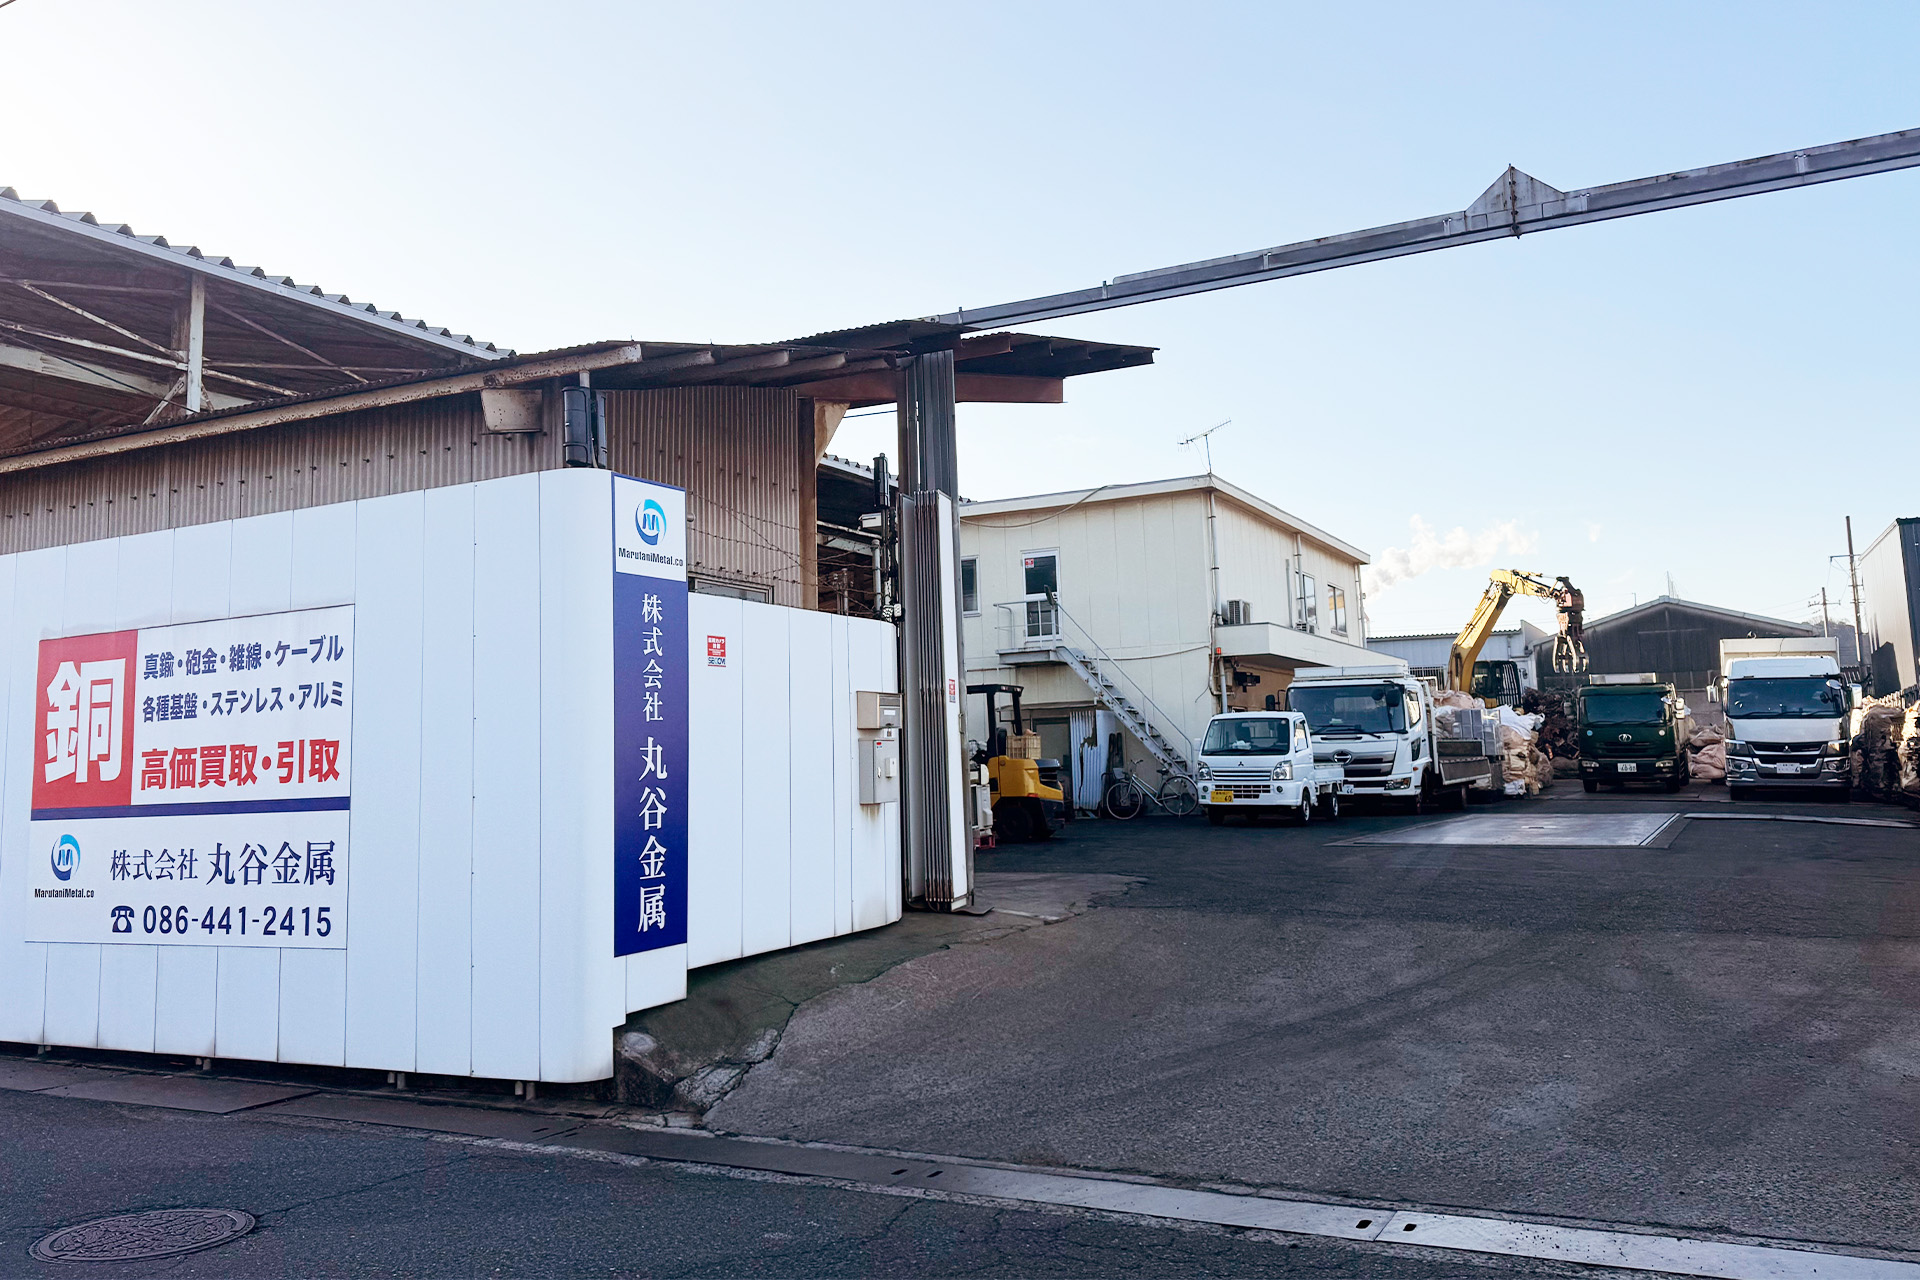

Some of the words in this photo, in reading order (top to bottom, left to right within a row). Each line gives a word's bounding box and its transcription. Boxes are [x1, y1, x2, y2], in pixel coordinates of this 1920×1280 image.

[618, 546, 684, 567] MarutaniMetal.co
[641, 594, 664, 722] 株式会社
[708, 656, 726, 665] SECOM
[45, 658, 126, 783] 銅
[143, 680, 343, 722] 各種基盤・ステンレス・アルミ
[140, 739, 340, 790] 高価買取・引取
[637, 736, 667, 932] 丸谷金属
[110, 849, 199, 882] 株式会社
[207, 840, 336, 886] 丸谷金属
[34, 888, 94, 899] MarutaniMetal.co
[143, 906, 332, 937] 086-441-2415
